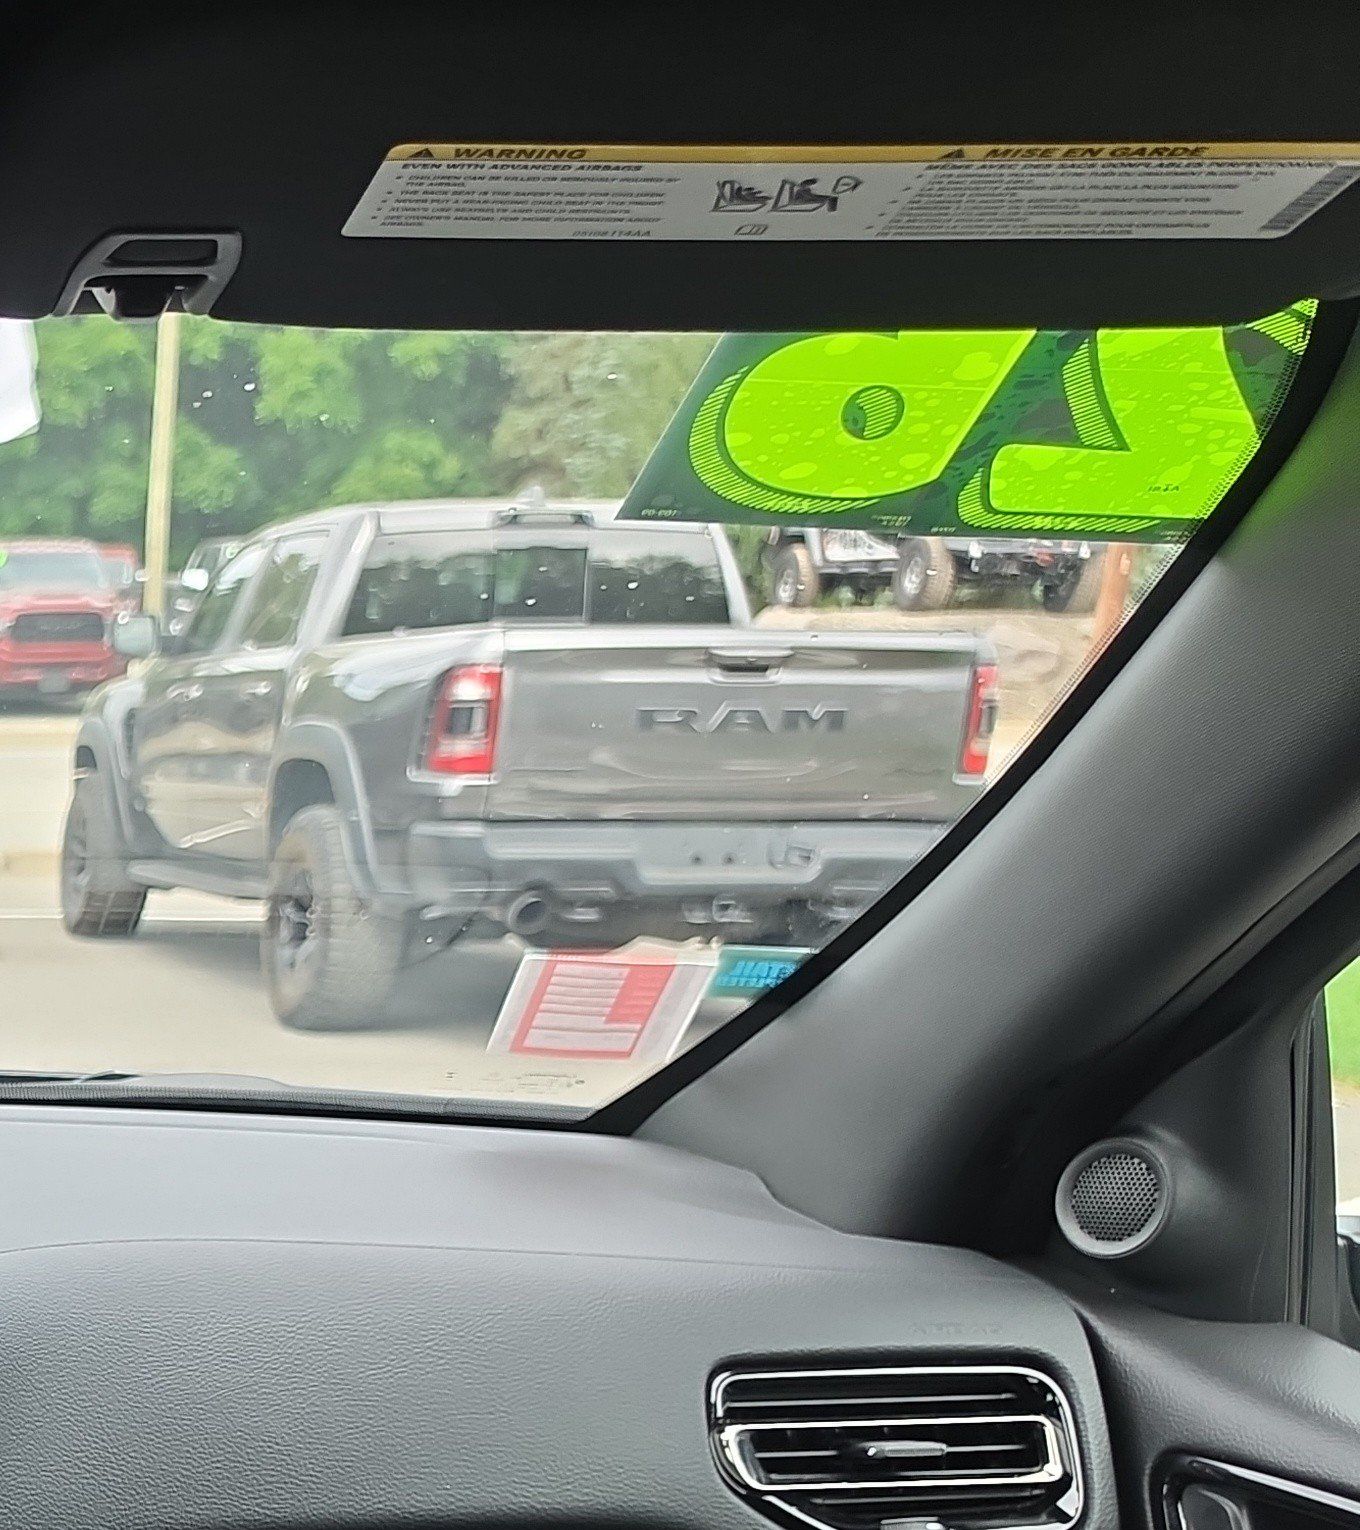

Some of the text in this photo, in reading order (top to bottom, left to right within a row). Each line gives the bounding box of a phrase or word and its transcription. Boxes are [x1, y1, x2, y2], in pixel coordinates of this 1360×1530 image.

[453, 148, 587, 160] WARNING
[983, 146, 1211, 159] MISE EN GARDE
[402, 163, 643, 173] EVEN WITH ADVANCED AIRBAGS
[635, 705, 850, 735] RAM
